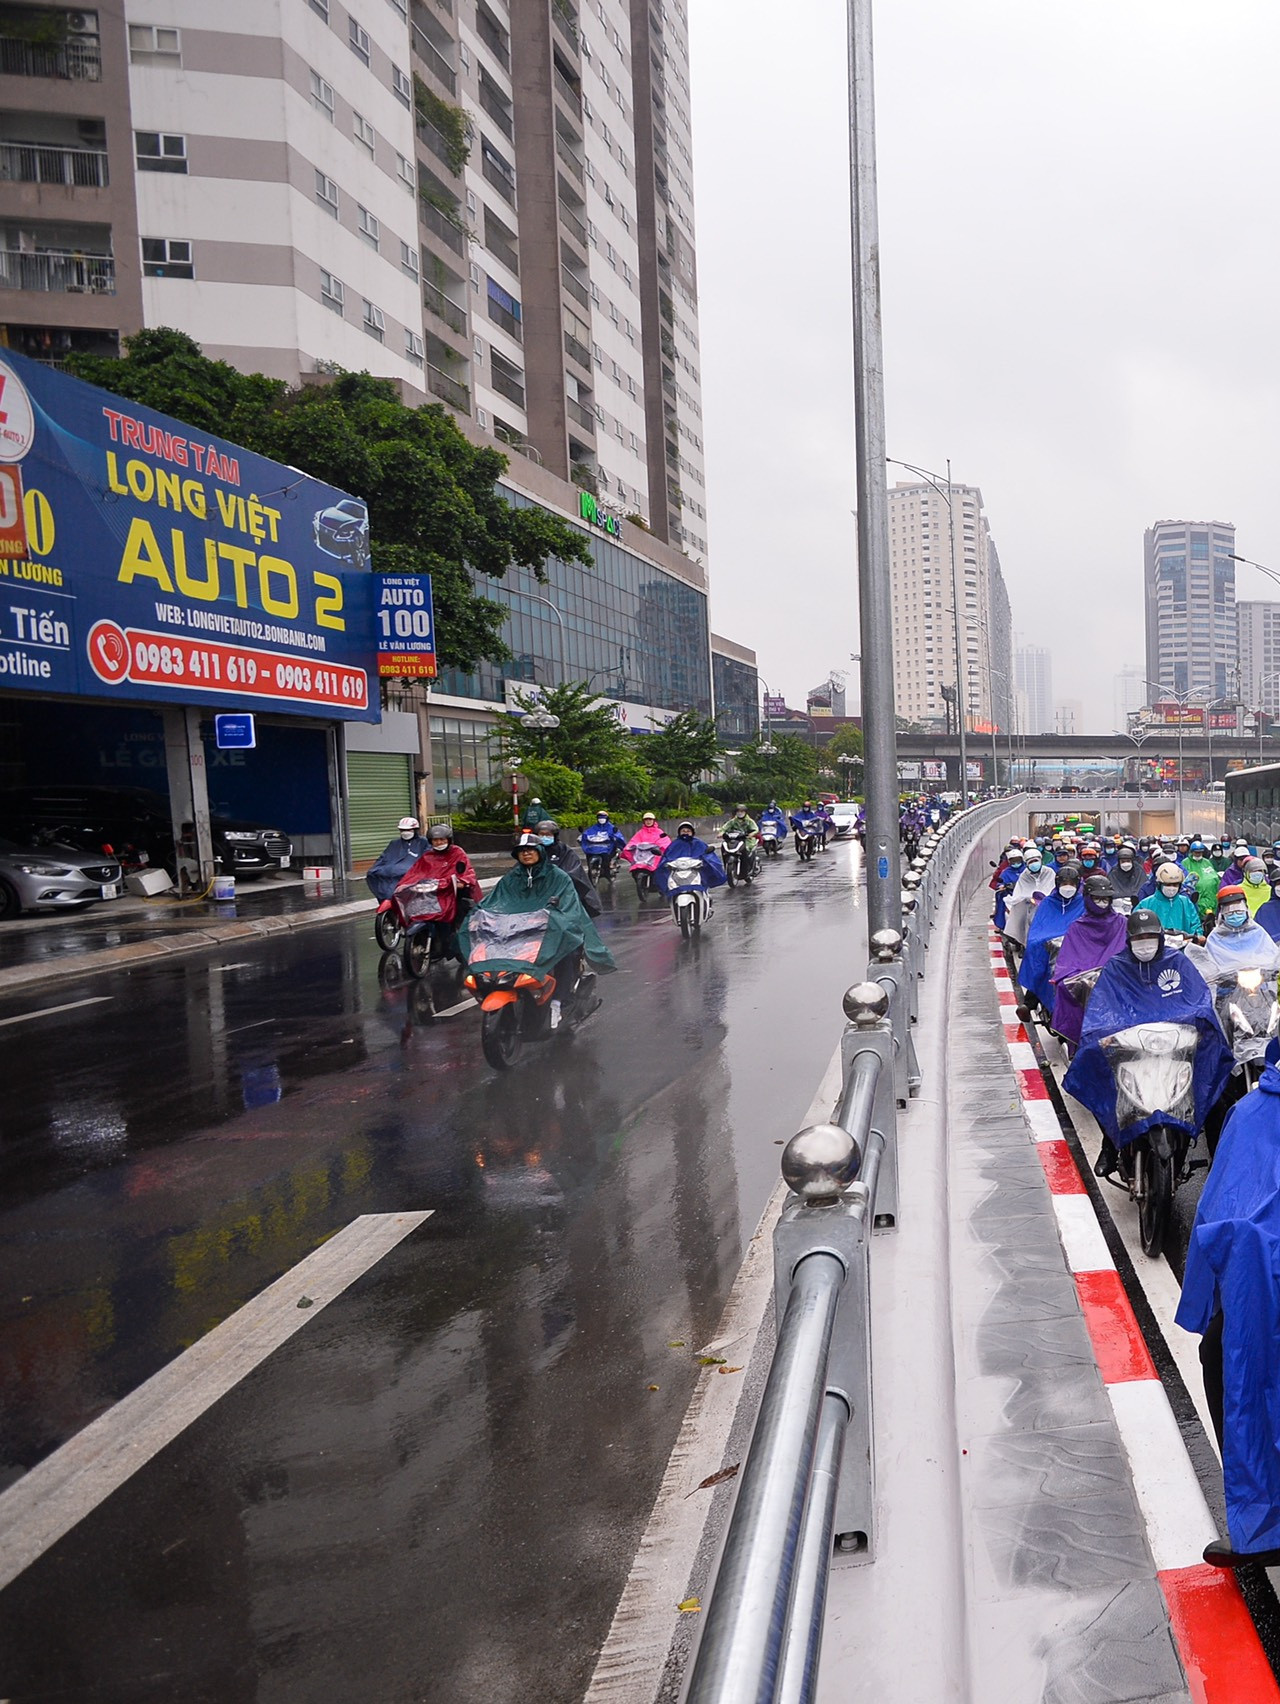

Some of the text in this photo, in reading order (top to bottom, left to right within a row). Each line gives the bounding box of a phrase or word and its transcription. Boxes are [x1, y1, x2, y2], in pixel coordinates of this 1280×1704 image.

[103, 406, 241, 487] TRUNG TÂM
[107, 450, 281, 545] LONG VIỆT
[12, 559, 63, 587] LƯƠNG
[117, 516, 346, 632] AUTO 2
[381, 588, 425, 606] AUTO
[10, 606, 70, 645] Tiến
[155, 602, 327, 652] WEB: LONGVIETAUTO2.BONBANH.COM
[377, 609, 430, 637] 100
[379, 639, 389, 650] LÊ
[389, 640, 406, 651] VĂN
[391, 655, 421, 663] HOTLINE:
[135, 641, 184, 677] 0983
[188, 655, 221, 681] 411
[226, 655, 257, 685] 619
[275, 662, 312, 693] 0903
[314, 670, 339, 697] 411
[341, 675, 364, 701] 619
[380, 664, 434, 674] 0983 411 619
